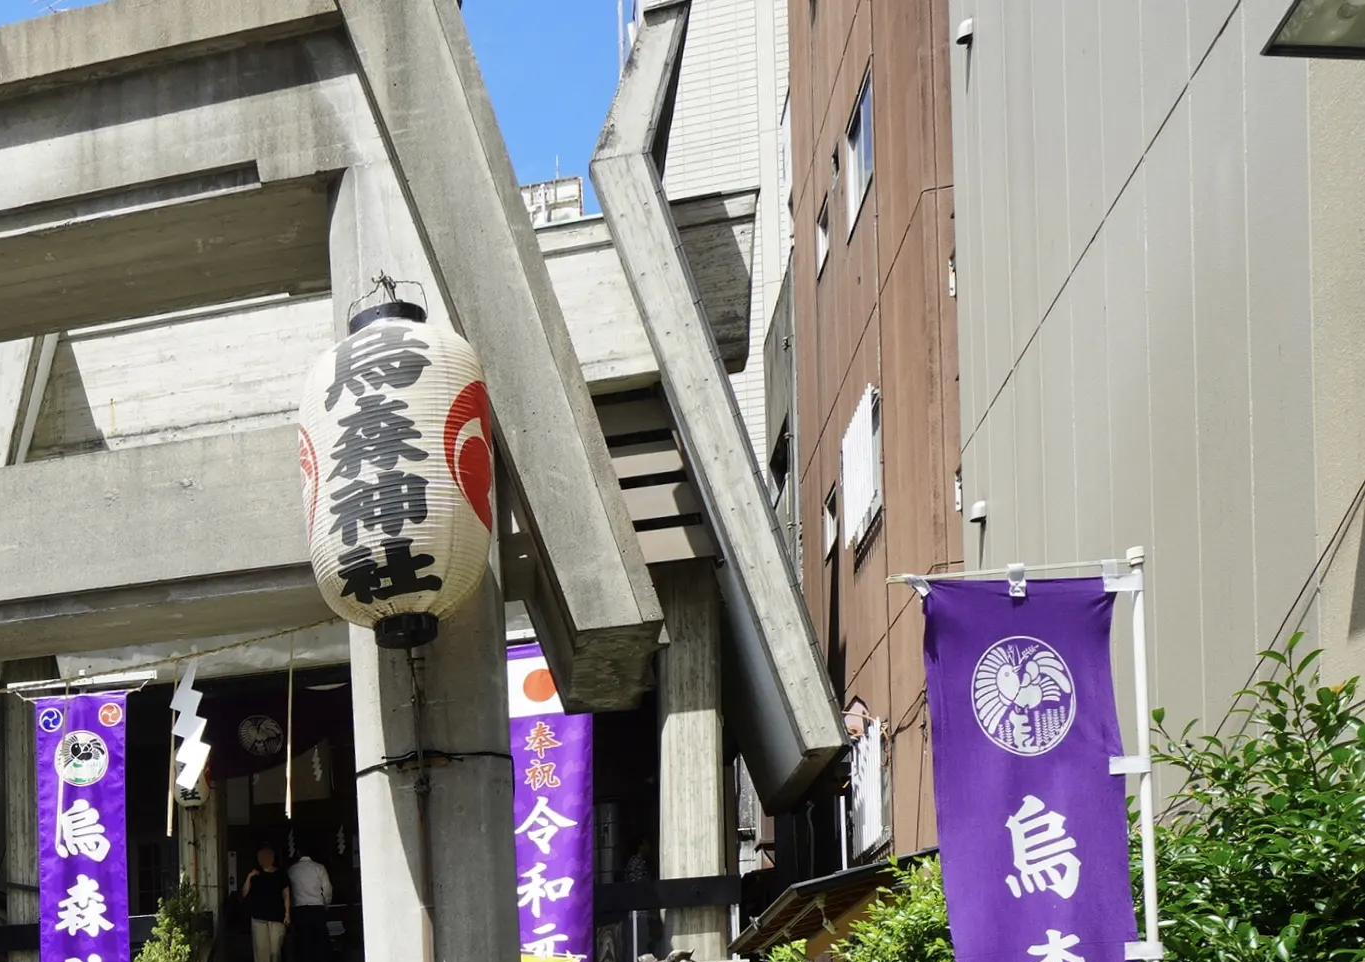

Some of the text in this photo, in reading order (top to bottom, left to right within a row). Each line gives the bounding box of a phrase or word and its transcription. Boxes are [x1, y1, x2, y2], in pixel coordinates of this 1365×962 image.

[325, 326, 443, 605] 烏森神社
[523, 721, 563, 791] 奉祝
